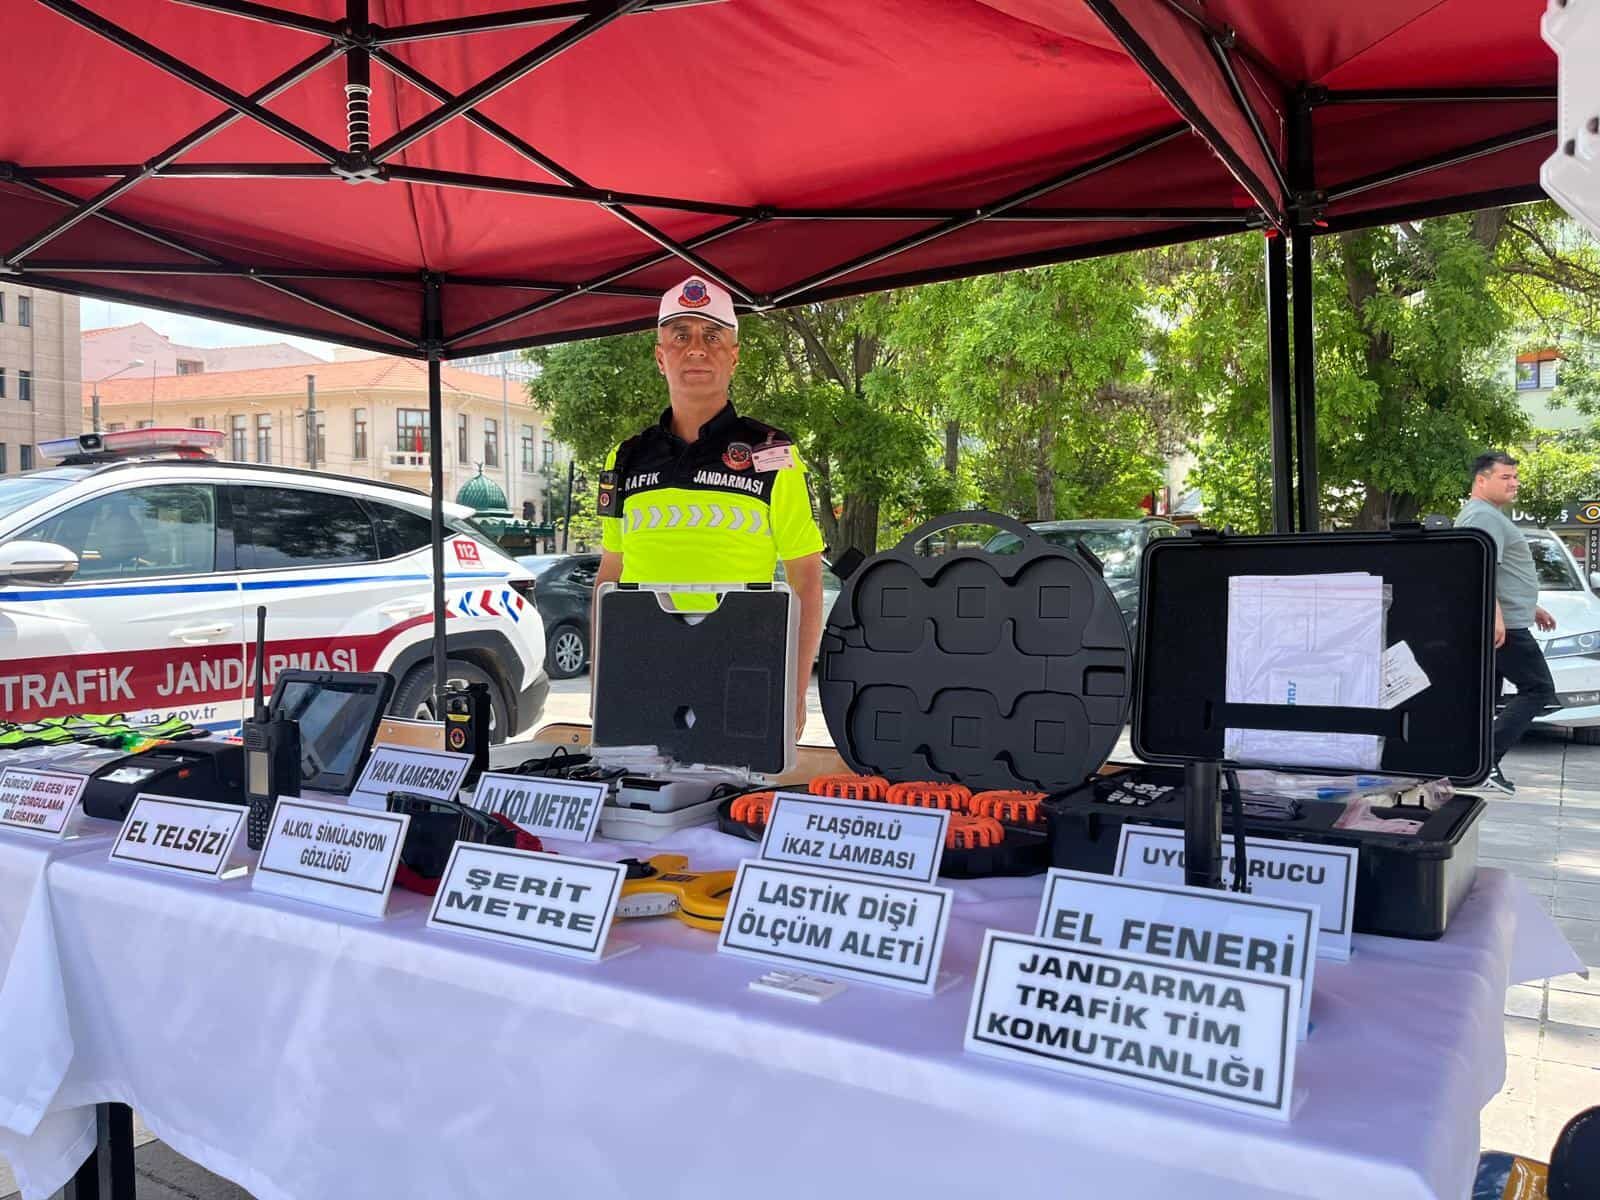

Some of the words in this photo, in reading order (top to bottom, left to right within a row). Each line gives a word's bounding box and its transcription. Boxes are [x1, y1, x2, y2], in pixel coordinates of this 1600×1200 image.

[693, 470, 763, 495] JANDARMASI
[457, 543, 477, 559] 112
[156, 648, 358, 696] JANDARMASI
[64, 784, 77, 796] VE
[369, 760, 399, 783] YAKA
[396, 763, 458, 792] KAMERASI
[481, 787, 593, 832] ALKOLMETRE
[806, 814, 903, 841] FLAŞÖRLÜ
[125, 820, 149, 844] EL
[152, 824, 230, 856] TELSİZİ
[281, 819, 313, 840] ALKOL
[316, 820, 388, 853] SİMÜLASYON
[781, 832, 825, 858] İKAZ
[828, 842, 915, 870] LAMBASI
[300, 846, 352, 873] GÖZLÜĞÜ
[1143, 847, 1326, 885] UYRUCU
[465, 868, 592, 904] ŞERİT
[445, 890, 596, 933] METRE
[758, 880, 851, 917] LASTİK
[858, 893, 918, 932] DİŞİ
[737, 908, 833, 947] ÖLÇÜM
[840, 931, 925, 967] ALETİ
[1051, 909, 1103, 946] EL
[1119, 918, 1297, 978] FENERİ
[1019, 954, 1247, 1013] JANDARMA
[1016, 984, 1150, 1031] TRAFİK
[1164, 1011, 1241, 1048] TİM
[986, 1012, 1265, 1093] KOMUTANLIĞI
